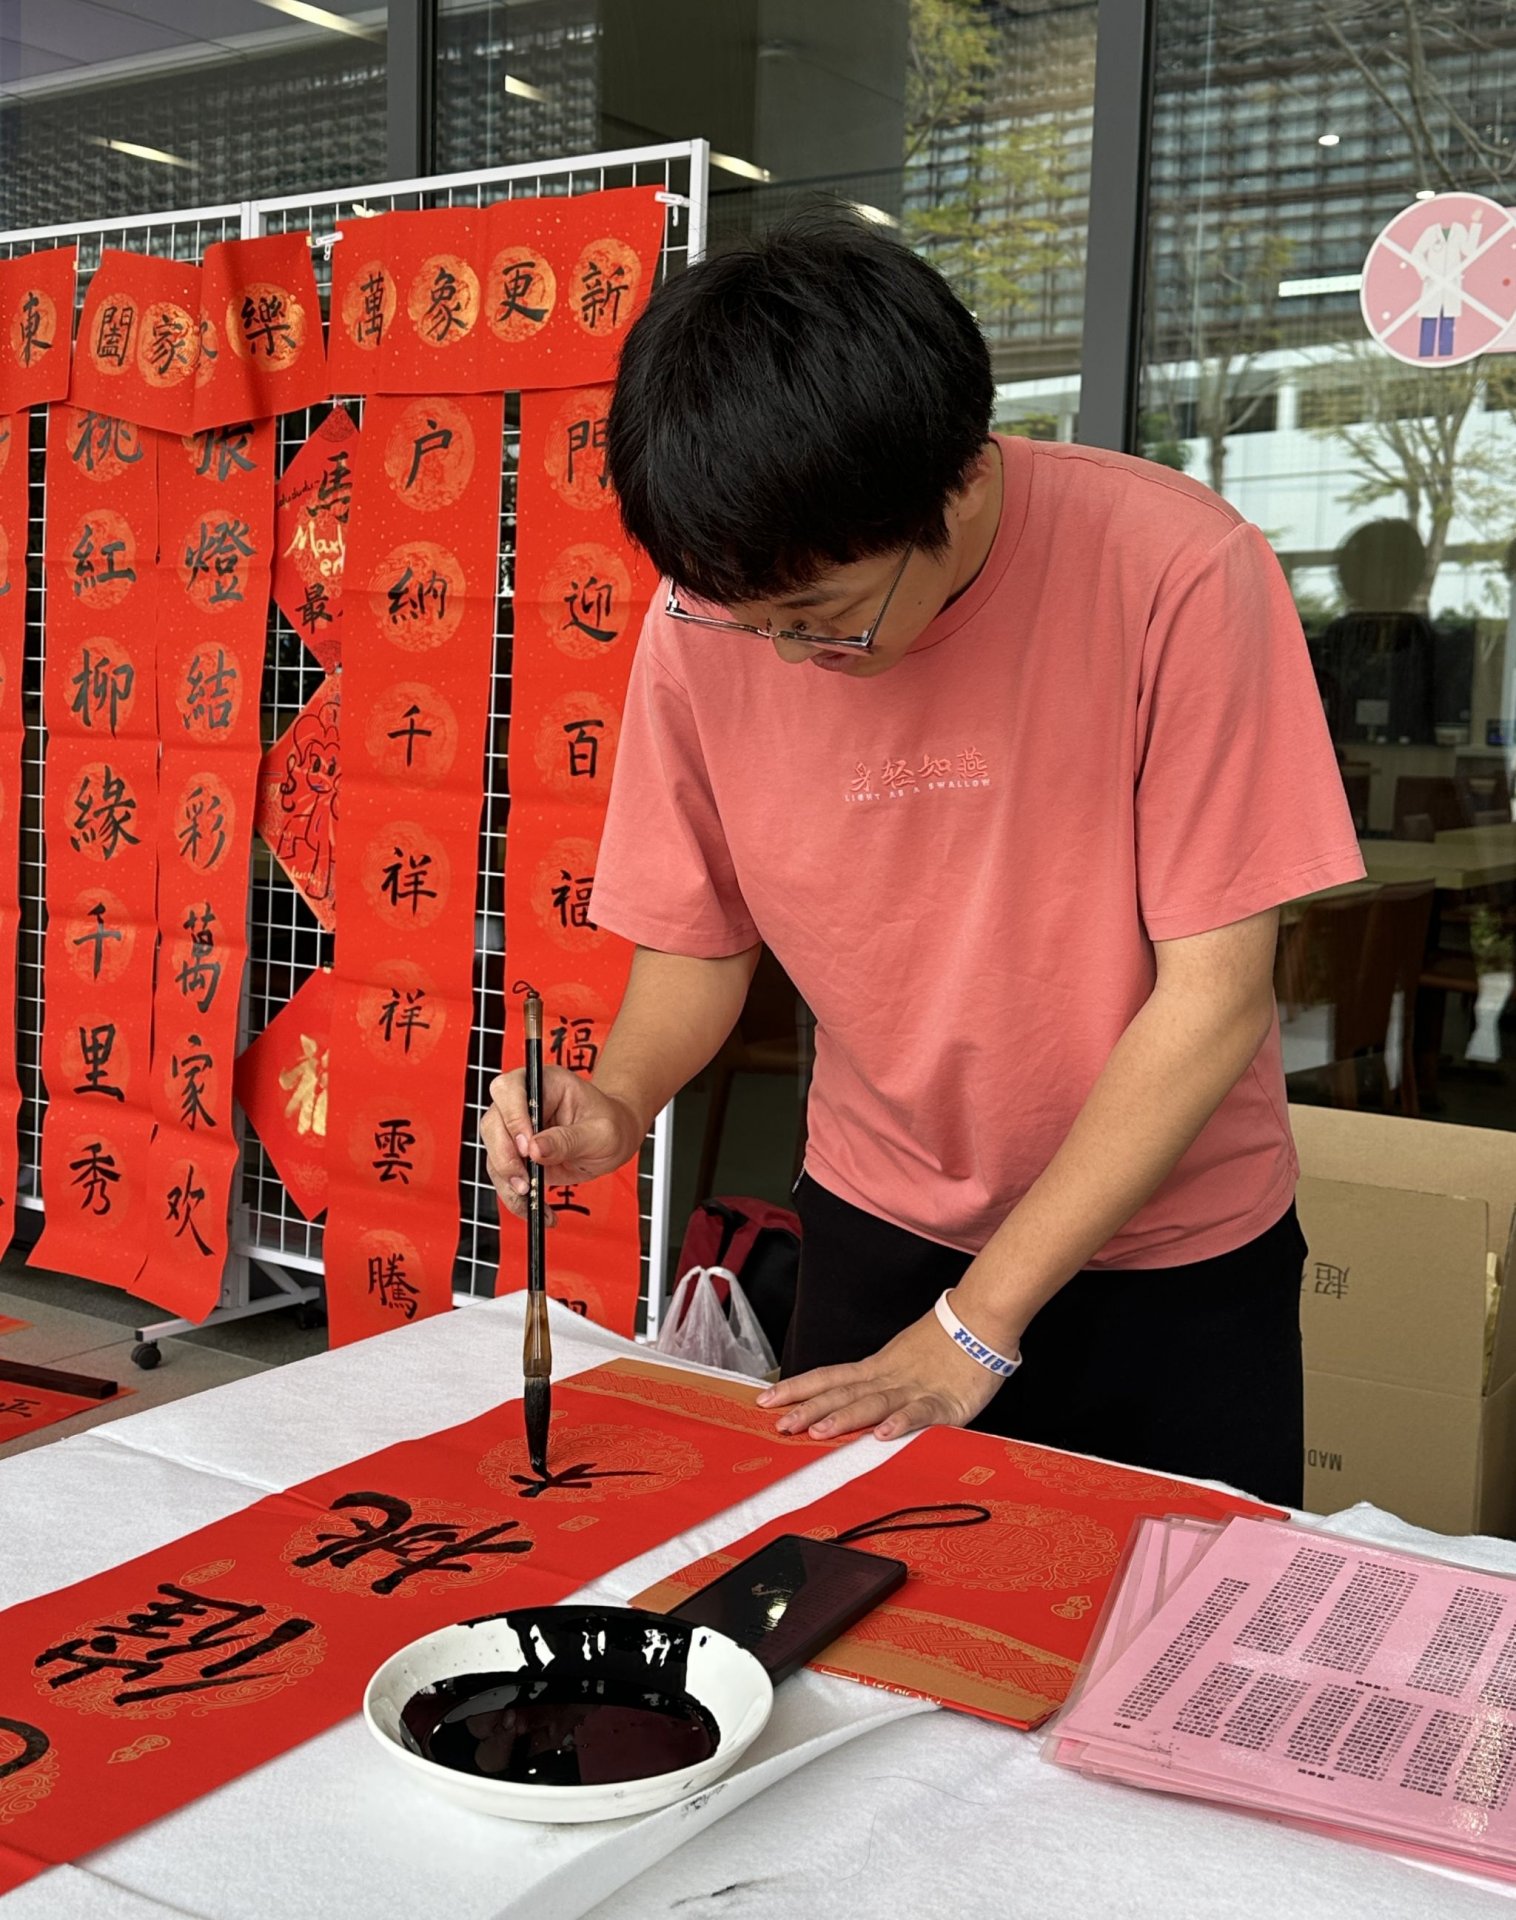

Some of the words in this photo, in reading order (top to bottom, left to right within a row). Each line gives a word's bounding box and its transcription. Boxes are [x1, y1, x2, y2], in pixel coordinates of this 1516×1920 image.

[357, 260, 629, 346] 萬象更新
[295, 583, 344, 634] 最
[844, 792, 881, 802] LIGHT
[889, 789, 904, 799] AS
[912, 786, 921, 794] A
[928, 778, 991, 790] SWALLOW
[849, 746, 988, 792] 身轻如燕
[550, 418, 617, 1317] 門迎百福福
[1300, 1261, 1351, 1299] 超
[1304, 1449, 1343, 1472] MAD
